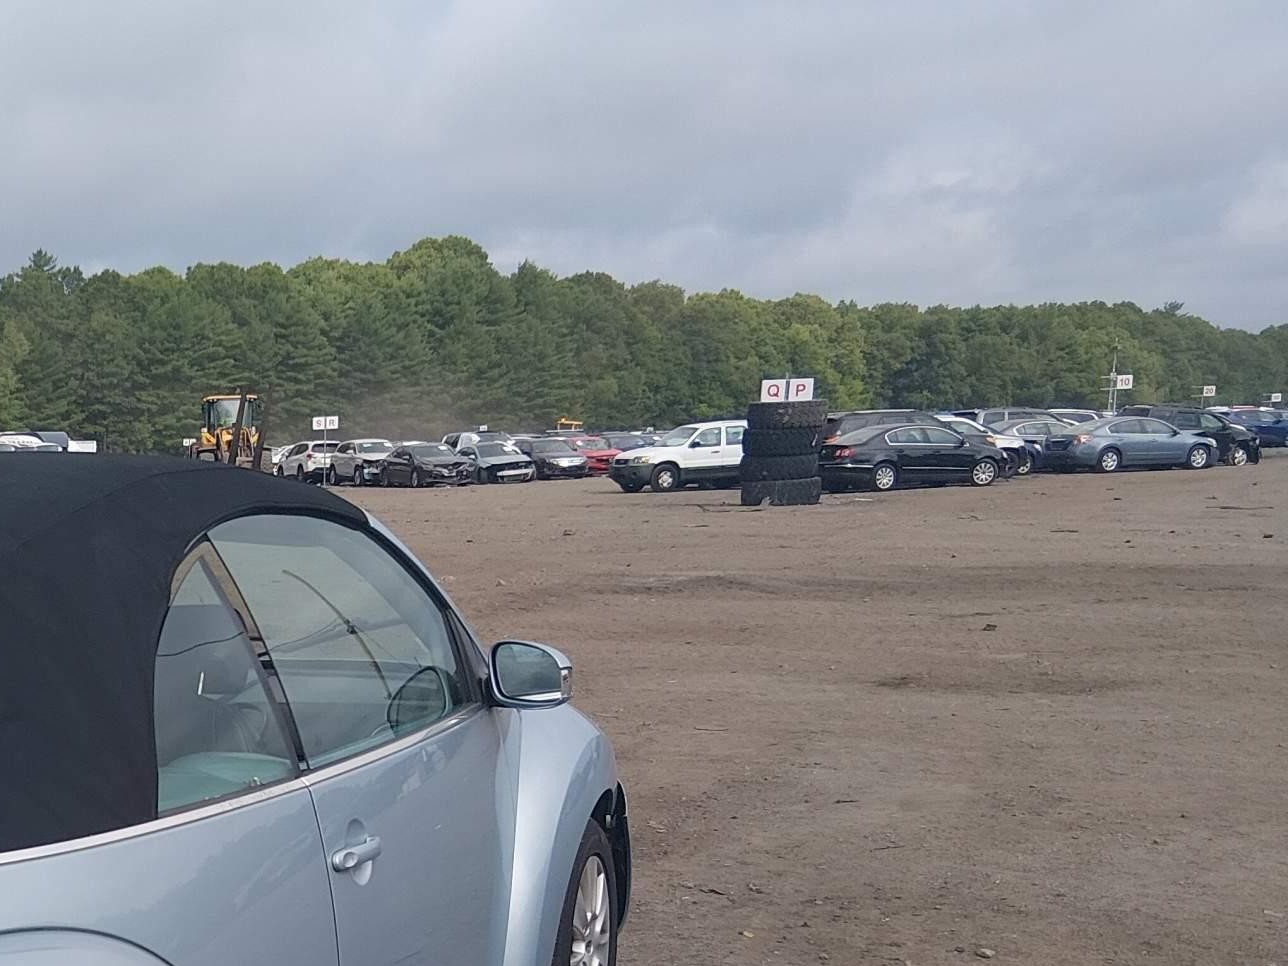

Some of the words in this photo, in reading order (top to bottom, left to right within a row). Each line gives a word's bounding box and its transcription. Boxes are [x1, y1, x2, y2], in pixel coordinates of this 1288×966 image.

[767, 384, 780, 398] Q
[795, 383, 807, 397] P
[316, 419, 322, 428] S
